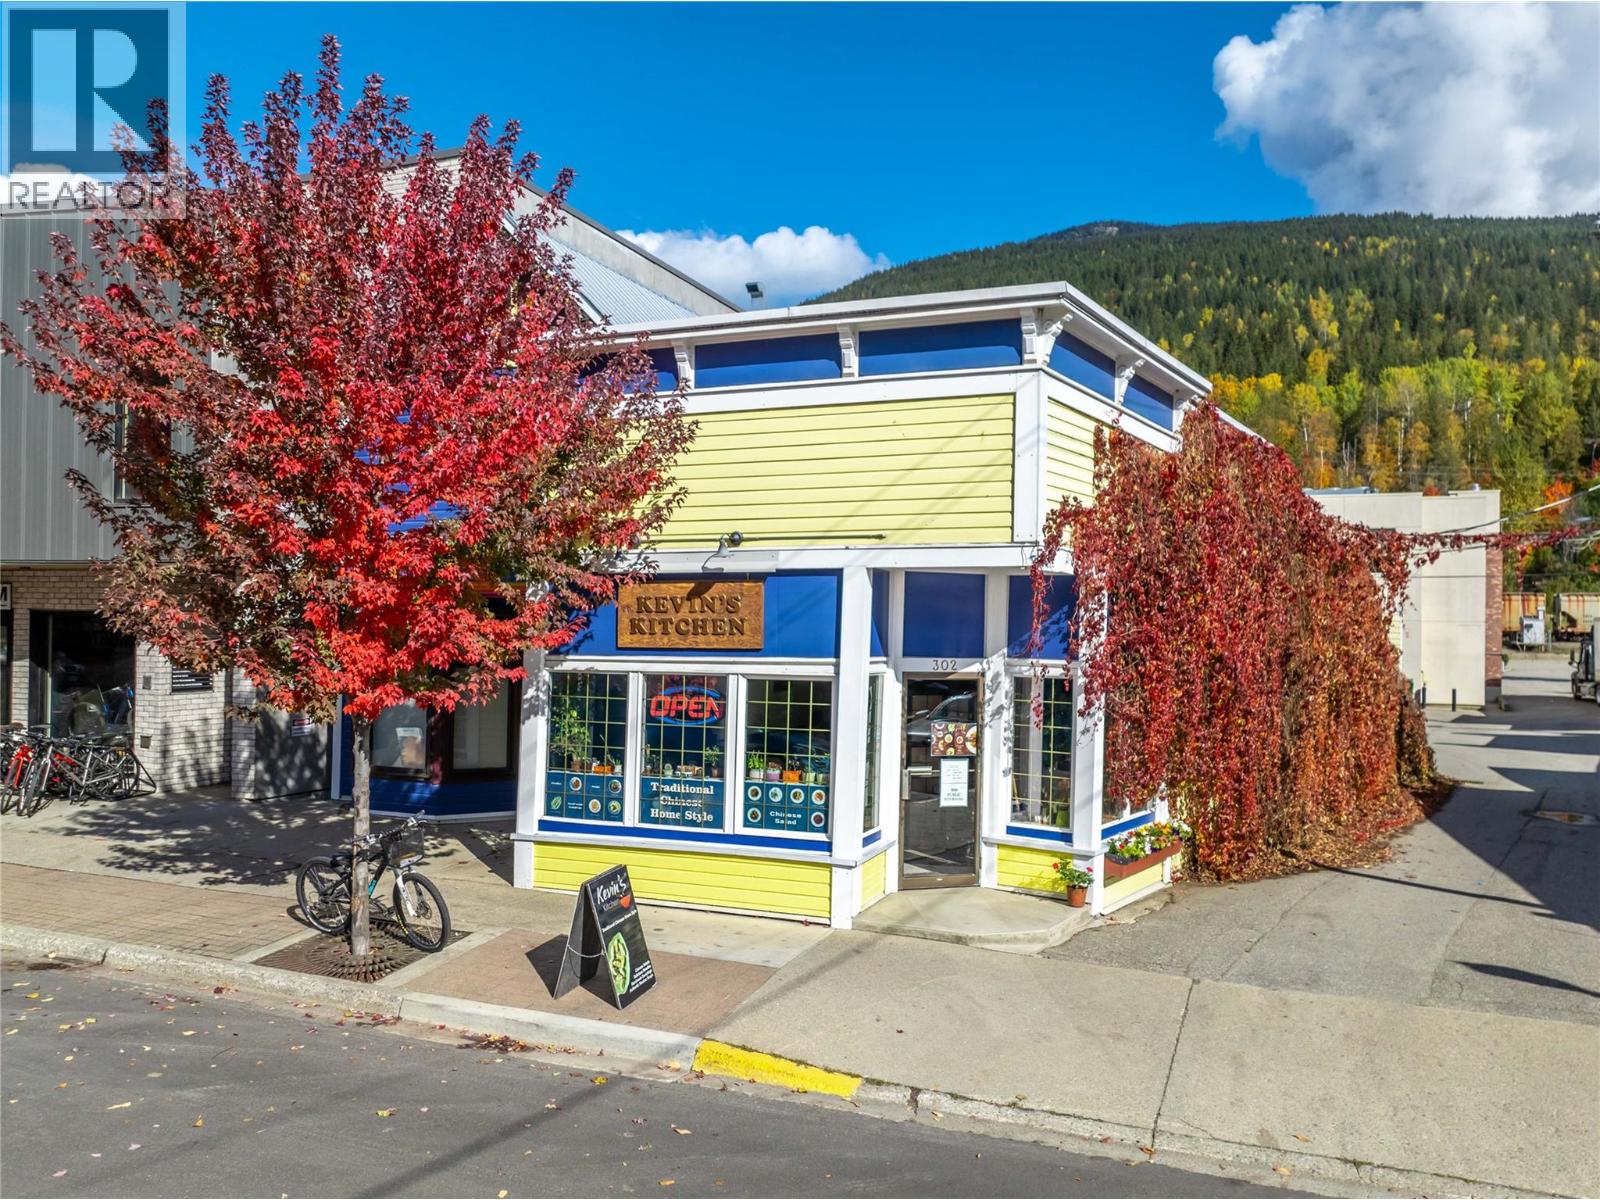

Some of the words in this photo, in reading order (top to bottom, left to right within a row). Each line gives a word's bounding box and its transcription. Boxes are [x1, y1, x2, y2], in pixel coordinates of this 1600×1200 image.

[636, 594, 742, 614] KEVIN'S
[629, 616, 747, 636] KITCHEN
[932, 659, 957, 671] 302
[650, 694, 724, 720] OPEN
[650, 782, 714, 795] Traditional
[660, 796, 703, 807] Chinese
[650, 808, 681, 820] Home
[684, 810, 714, 823] Style
[597, 874, 627, 904] Kevin's
